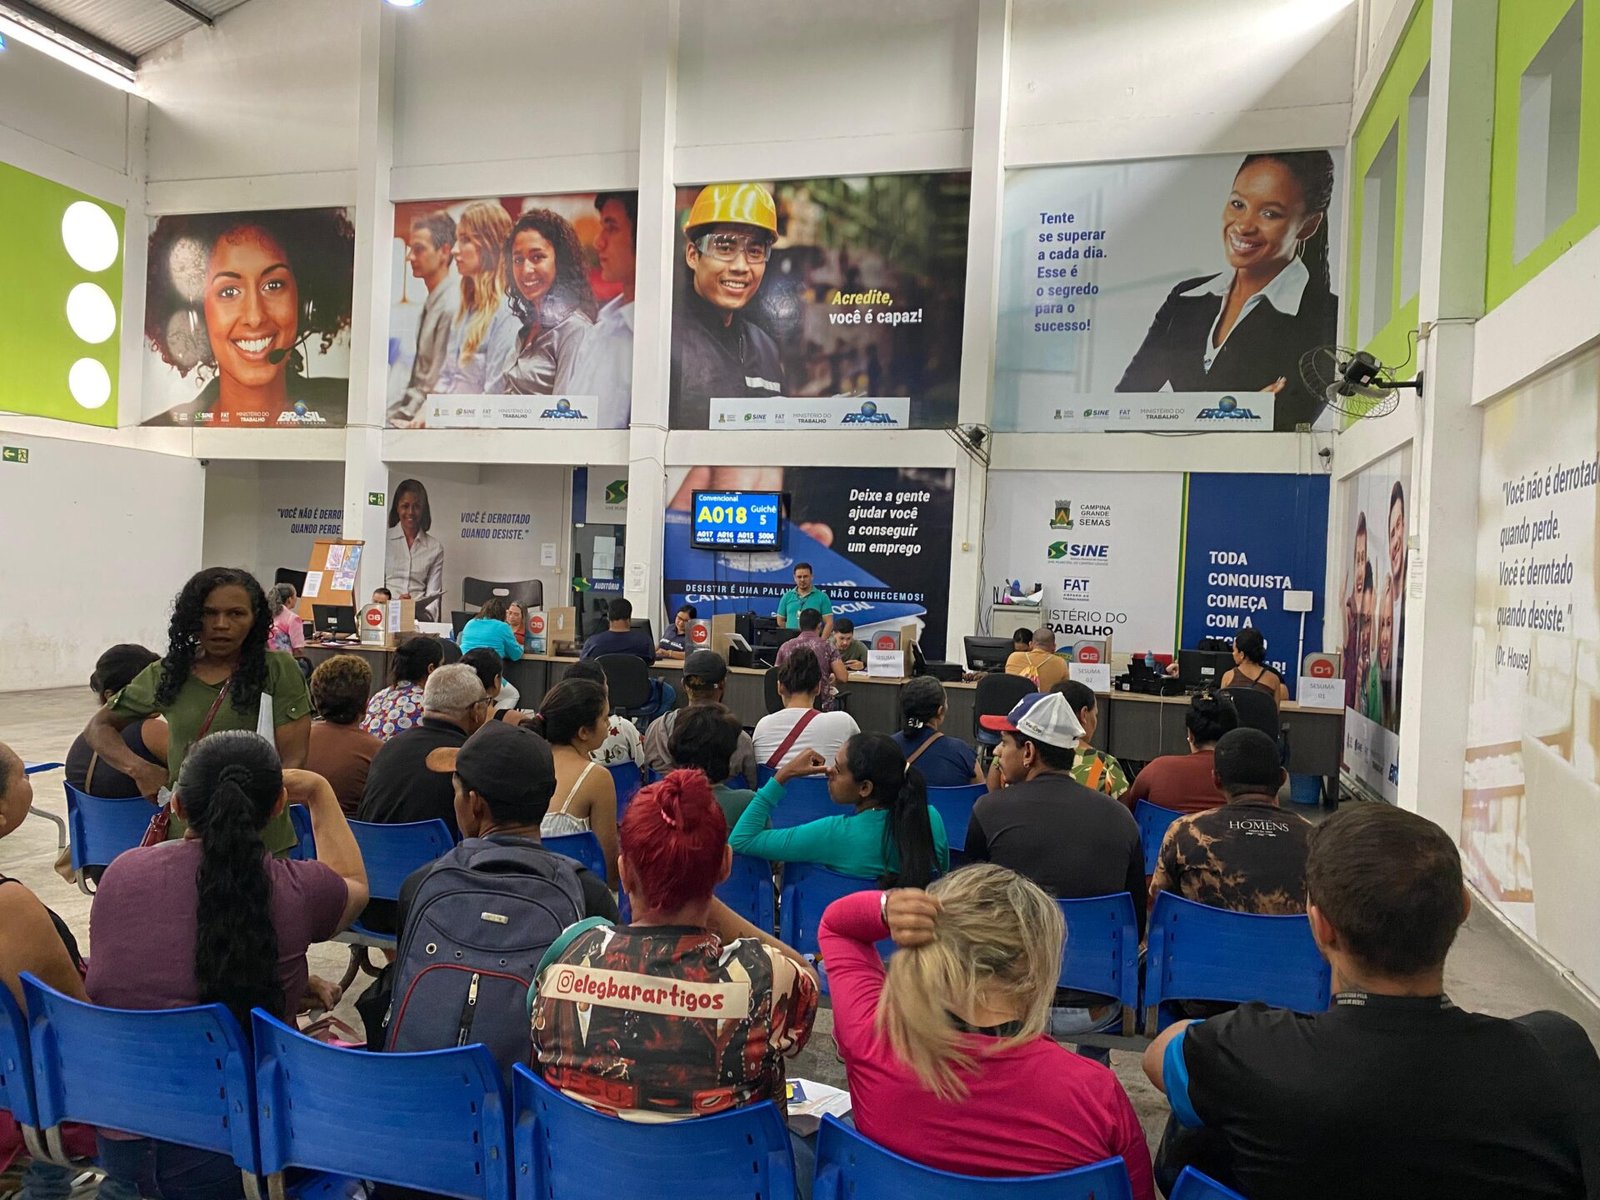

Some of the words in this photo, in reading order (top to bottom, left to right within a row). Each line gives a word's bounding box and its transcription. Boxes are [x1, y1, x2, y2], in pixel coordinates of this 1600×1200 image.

[1040, 212, 1075, 225] Tente
[1038, 232, 1053, 243] se
[1056, 230, 1106, 244] superar
[1037, 251, 1045, 261] a
[1049, 247, 1079, 260] cada
[1083, 245, 1107, 259] dia.
[1037, 266, 1067, 279] Esse
[1070, 264, 1078, 278] é
[831, 289, 894, 307] Acredite,
[1036, 287, 1044, 297] o
[1048, 282, 1099, 299] segredo
[829, 309, 861, 325] você
[864, 309, 873, 323] é
[876, 308, 923, 327] capaz!
[1035, 304, 1063, 317] para
[1067, 303, 1075, 314] o
[1034, 318, 1091, 333] sucesso!
[276, 410, 327, 422] BRASIL
[540, 408, 588, 419] BRASIL
[840, 412, 898, 423] BRASIL
[1196, 407, 1262, 419] BRASIL
[1502, 475, 1525, 507] "Você
[1526, 470, 1543, 502] não
[1545, 466, 1551, 496] é
[698, 494, 739, 502] Convencional
[849, 488, 883, 502] Deixe
[885, 492, 893, 502] a
[895, 490, 930, 505] gente
[277, 506, 297, 519] "VOCÊ
[298, 507, 313, 519] NÃO
[314, 507, 319, 519] É
[319, 509, 343, 520] DERROT
[697, 505, 747, 524] A018
[751, 504, 777, 514] Guichê
[849, 506, 887, 521] ajudar
[889, 506, 918, 519] você
[460, 511, 480, 523] VOCÊ
[480, 511, 487, 523] É
[487, 513, 531, 524] DERROTADO
[760, 514, 767, 525] 5
[1079, 518, 1111, 526] SEMAS
[290, 523, 318, 534] QUANDO
[461, 528, 491, 539] QUANDO
[492, 529, 530, 540] DESISTE."
[848, 525, 856, 535] a
[858, 523, 918, 539] conseguir
[1500, 516, 1530, 552] quando
[1531, 509, 1560, 548] perde.
[848, 542, 866, 553] um
[869, 542, 921, 557] emprego
[1209, 551, 1248, 566] TODA
[1500, 559, 1518, 586] Você
[1520, 558, 1525, 585] é
[1527, 553, 1573, 585] derrotado
[593, 582, 620, 591] AUDITÓRIO
[1063, 579, 1090, 591] FAT
[1208, 572, 1292, 589] CONQUISTA
[685, 584, 727, 594] DESISTIR
[730, 584, 736, 594] É
[739, 586, 759, 595] UMA
[762, 588, 793, 596] PALAV
[830, 589, 850, 599] NÃO
[853, 590, 924, 602] CONHECEMOS!
[831, 601, 875, 615] OCIAL
[1207, 594, 1268, 613] COMEÇA
[1048, 608, 1102, 623] ISTÉRIO
[1105, 612, 1128, 624] DO
[1206, 614, 1239, 629] COM
[1242, 616, 1253, 629] A
[1496, 599, 1526, 632] quando
[1528, 600, 1572, 632] desiste."
[1046, 622, 1114, 637] RABALHO
[1080, 652, 1098, 661] 02
[1495, 645, 1506, 673] (Dr.
[1507, 646, 1531, 676] House)
[1313, 666, 1332, 675] 01
[1310, 682, 1336, 690] SESUMA
[1229, 820, 1290, 832] HOMENS
[574, 974, 725, 1012] elegbarartigos
